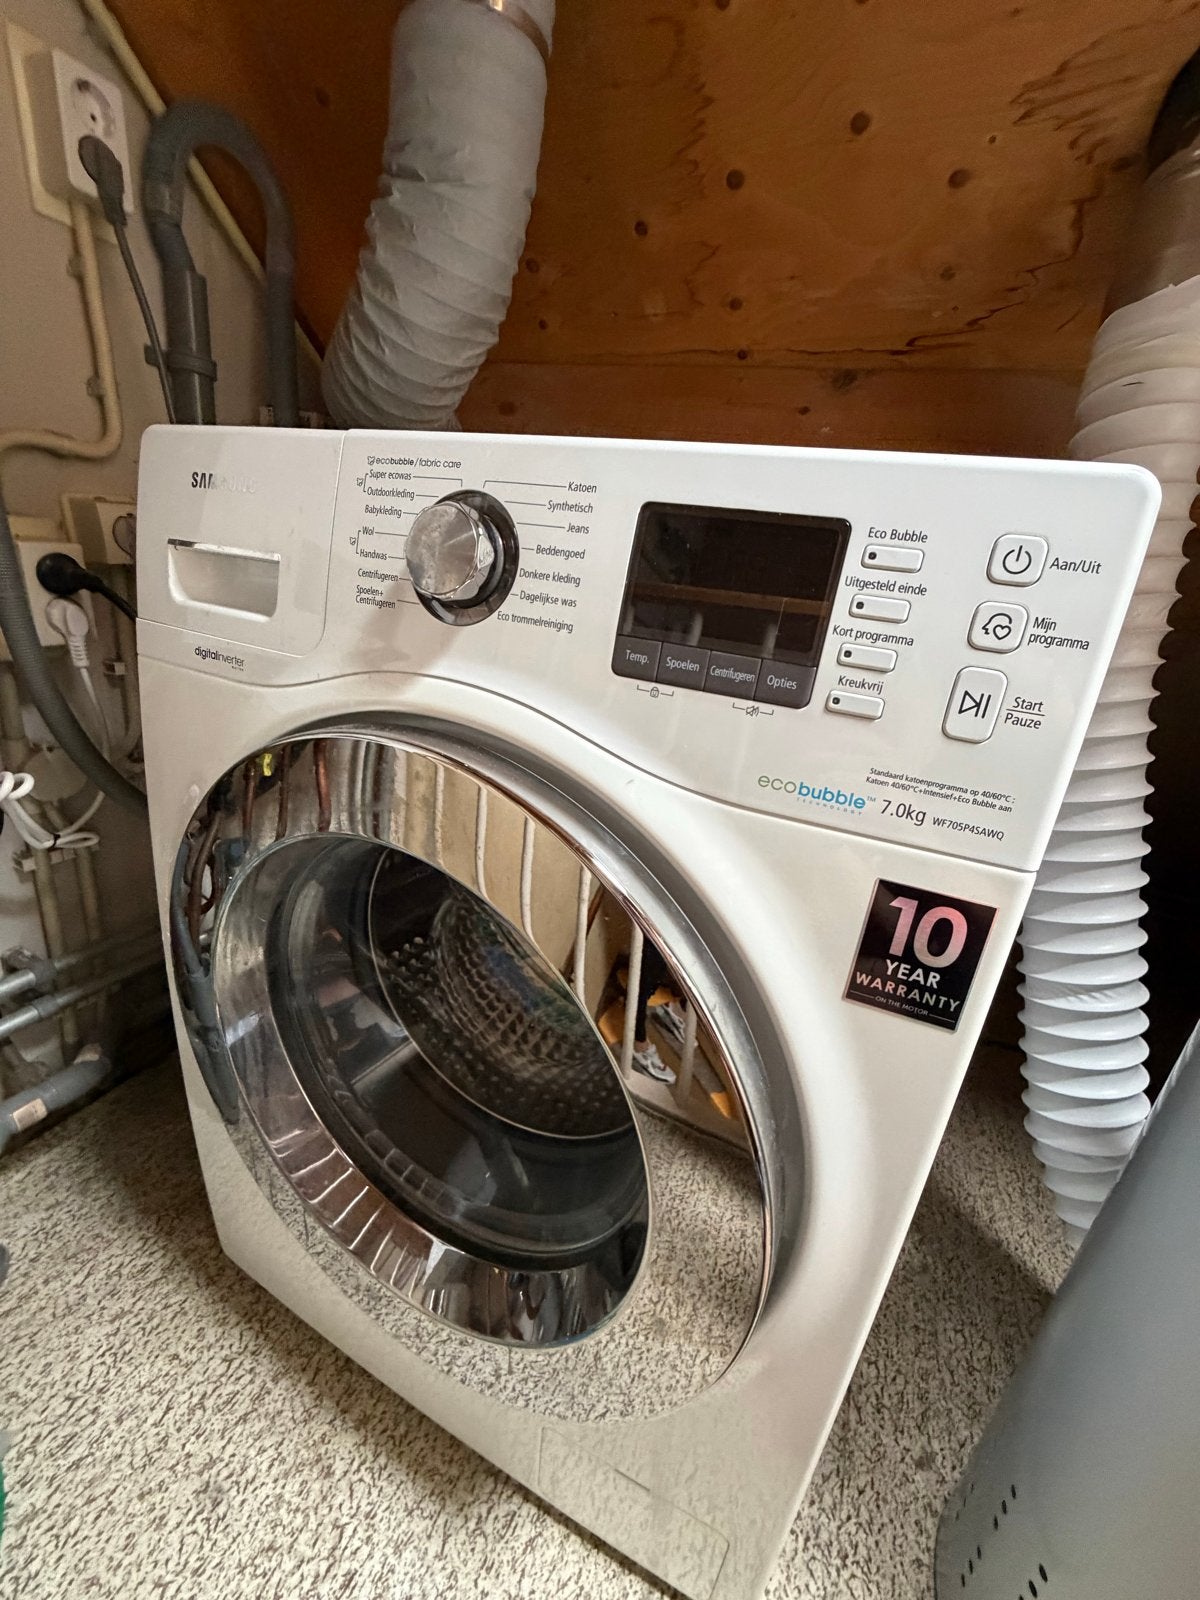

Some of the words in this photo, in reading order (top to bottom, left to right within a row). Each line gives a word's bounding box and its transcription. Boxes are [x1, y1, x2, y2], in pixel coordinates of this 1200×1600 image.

[442, 460, 462, 469] care
[369, 468, 387, 480] Super
[389, 472, 412, 480] ecowas
[366, 486, 415, 502] Outdoorkleding
[568, 481, 598, 494] Katoen
[364, 504, 402, 518] Babykleding
[547, 500, 594, 514] Synthetisch
[362, 526, 374, 536] Wol
[566, 522, 590, 534] Jeans
[868, 526, 887, 541] Eco
[890, 528, 928, 544] Bubble
[360, 548, 388, 560] Handwas
[536, 544, 586, 560] Beddengoed
[1050, 556, 1102, 574] Aan/Uit
[358, 568, 398, 582] Centrifugeren
[519, 568, 550, 582] Donkere
[552, 571, 581, 588] kleding
[356, 584, 384, 596] Spoelen+
[844, 576, 896, 592] Uitgesteld
[898, 580, 928, 596] einde
[355, 594, 396, 609] Centrifugeren
[520, 590, 559, 606] Dagelijkse
[561, 598, 577, 608] was
[497, 610, 510, 622] Eco
[512, 614, 574, 634] trommelreiniging
[1032, 616, 1057, 632] Mijn
[832, 624, 854, 638] Kort
[854, 628, 914, 646] programma
[1027, 632, 1090, 651] programma
[626, 649, 650, 664] Temp.
[666, 656, 700, 674] Spoelen
[710, 665, 756, 682] Centrifugeren
[766, 674, 797, 690] Opties
[837, 675, 884, 694] Kreukvrij
[1012, 696, 1044, 712] Start
[1004, 712, 1042, 730] Pauze
[870, 768, 904, 781] Standaard
[905, 774, 968, 794] katoenprogramma
[866, 776, 890, 787] Katoen
[972, 798, 997, 810] Bubble
[998, 804, 1012, 812] aan
[880, 798, 928, 826] 7.0kg
[932, 816, 1004, 841] WF705P4SAWQ
[888, 896, 968, 968] 10
[886, 958, 941, 989] YEAR
[856, 972, 960, 1012] WARRANTY
[875, 996, 886, 1004] ON
[888, 1000, 900, 1008] THE
[902, 1004, 929, 1016] MOTOR
